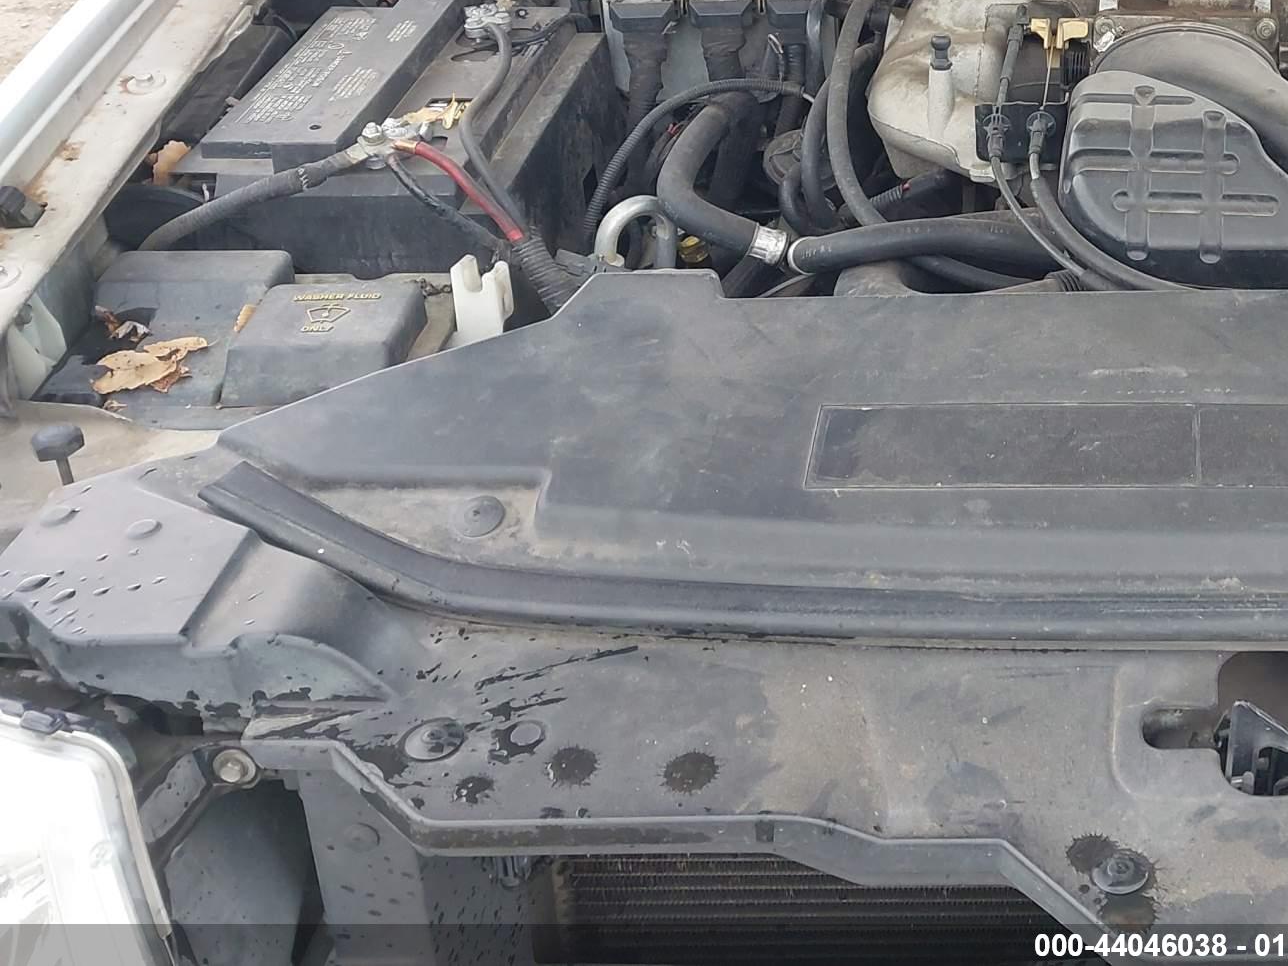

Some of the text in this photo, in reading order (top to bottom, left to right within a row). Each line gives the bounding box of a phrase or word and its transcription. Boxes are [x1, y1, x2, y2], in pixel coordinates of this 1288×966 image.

[294, 292, 381, 302] WASHER FLUID
[300, 324, 334, 333] ONLY
